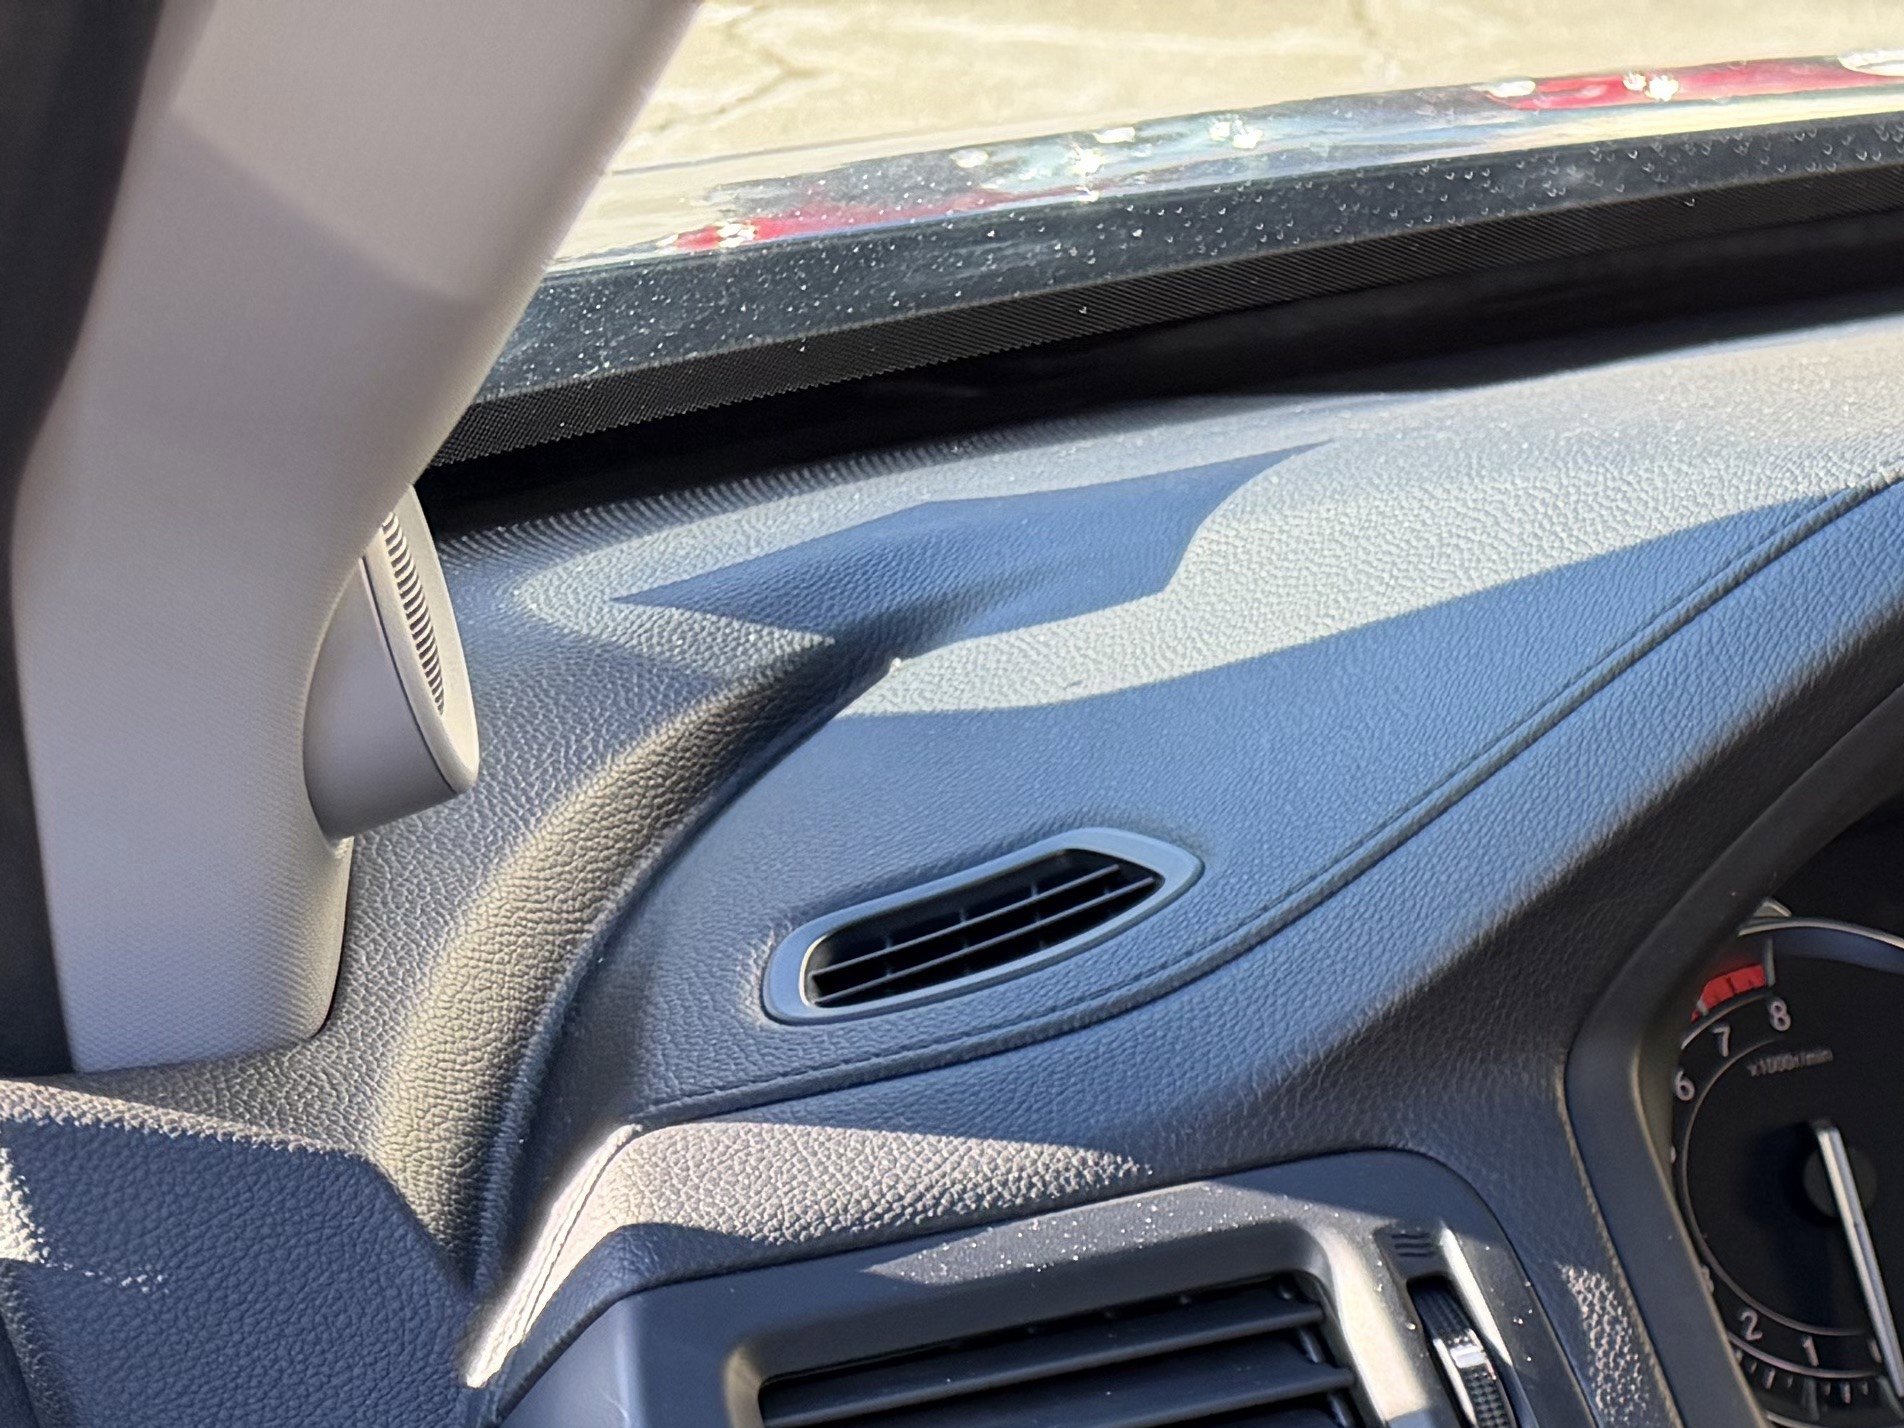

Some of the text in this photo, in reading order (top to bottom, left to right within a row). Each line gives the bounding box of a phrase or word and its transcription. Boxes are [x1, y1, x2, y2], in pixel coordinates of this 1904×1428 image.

[1771, 999, 1790, 1030] 8
[1713, 1026, 1730, 1056] 7
[1676, 1071, 1695, 1100] 6
[1741, 1307, 1762, 1340] 2
[1803, 1336, 1818, 1366] 1
